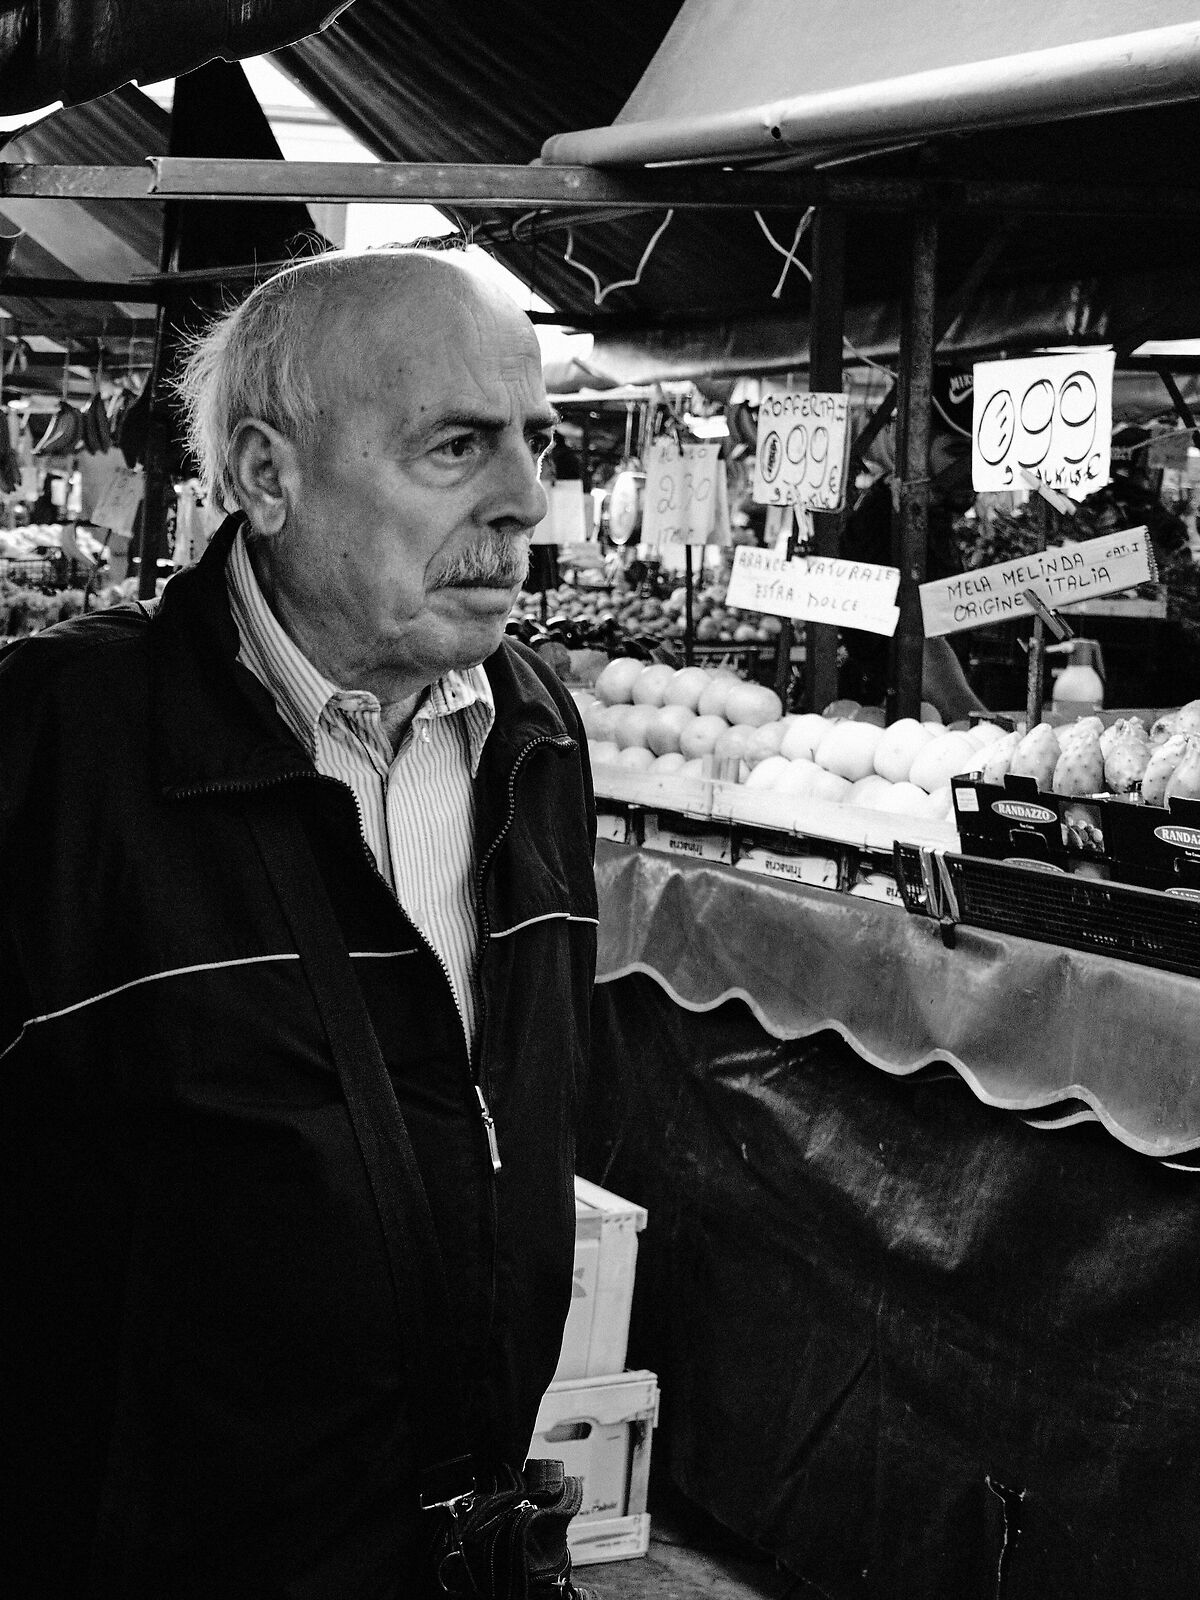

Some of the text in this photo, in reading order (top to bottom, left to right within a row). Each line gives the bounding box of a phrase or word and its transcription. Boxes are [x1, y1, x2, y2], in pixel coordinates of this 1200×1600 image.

[949, 374, 974, 391] NIK
[947, 576, 992, 600] MELA
[1002, 553, 1085, 588] MELINDA
[755, 579, 859, 612] ESTRA DOLCE
[953, 566, 1112, 622] ORIGINE ITALIA
[998, 803, 1050, 821] RANDAZZO
